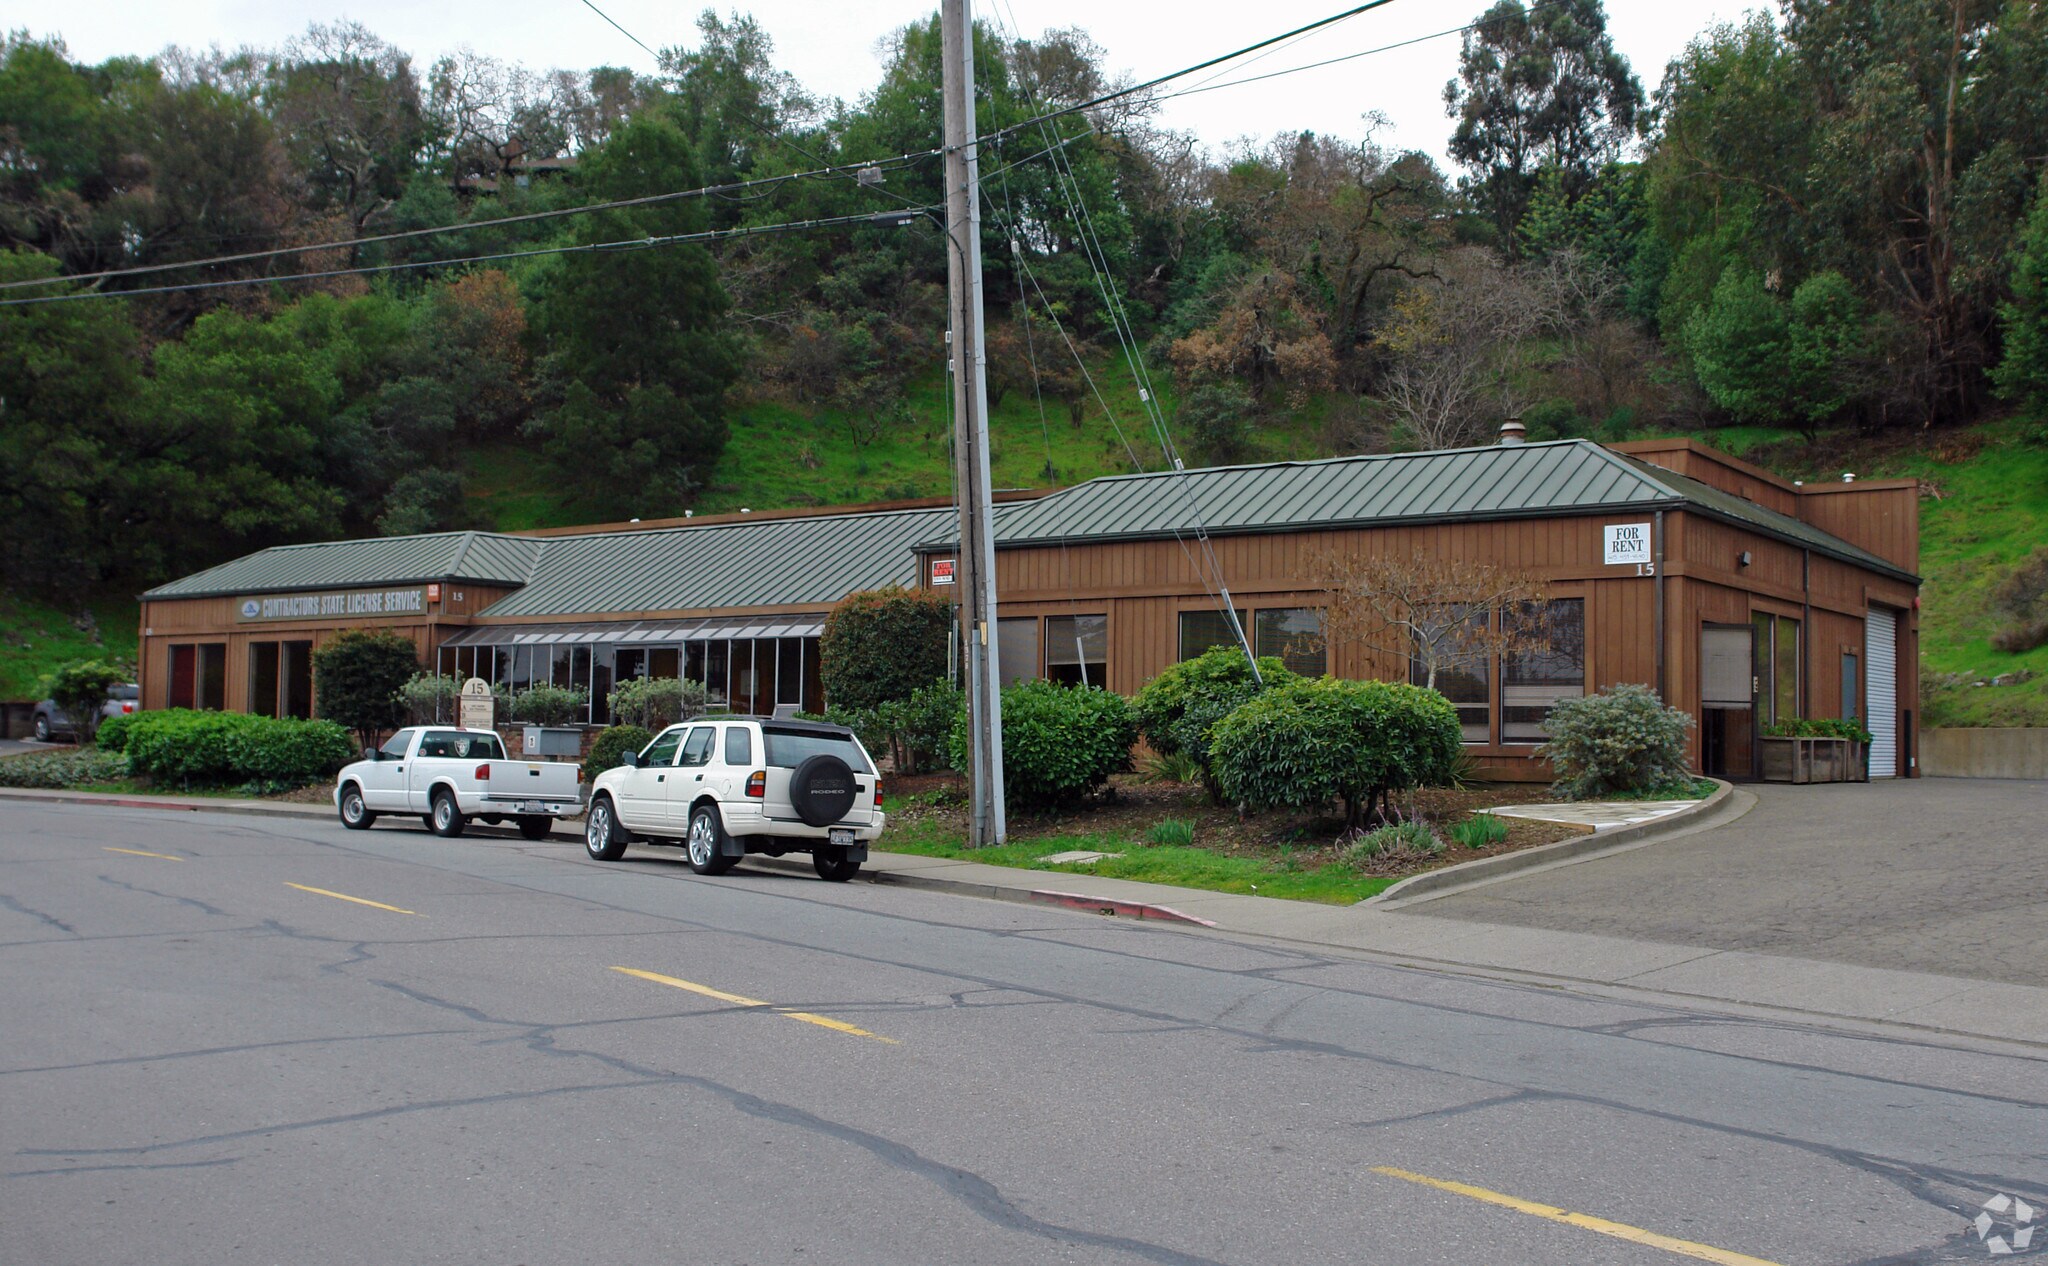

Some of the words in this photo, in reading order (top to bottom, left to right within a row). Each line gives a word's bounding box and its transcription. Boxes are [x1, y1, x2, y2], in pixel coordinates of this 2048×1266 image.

[1616, 527, 1639, 540] FOR
[1612, 539, 1644, 552] RENT
[933, 568, 954, 576] RENT
[936, 562, 951, 570] FOR
[1637, 562, 1655, 576] 15
[452, 592, 463, 601] 15
[262, 596, 319, 617] CONTRACTORS
[321, 595, 345, 615] STATE
[347, 592, 382, 613] LICENSE
[385, 590, 421, 612] SERVICE
[471, 682, 484, 695] 15
